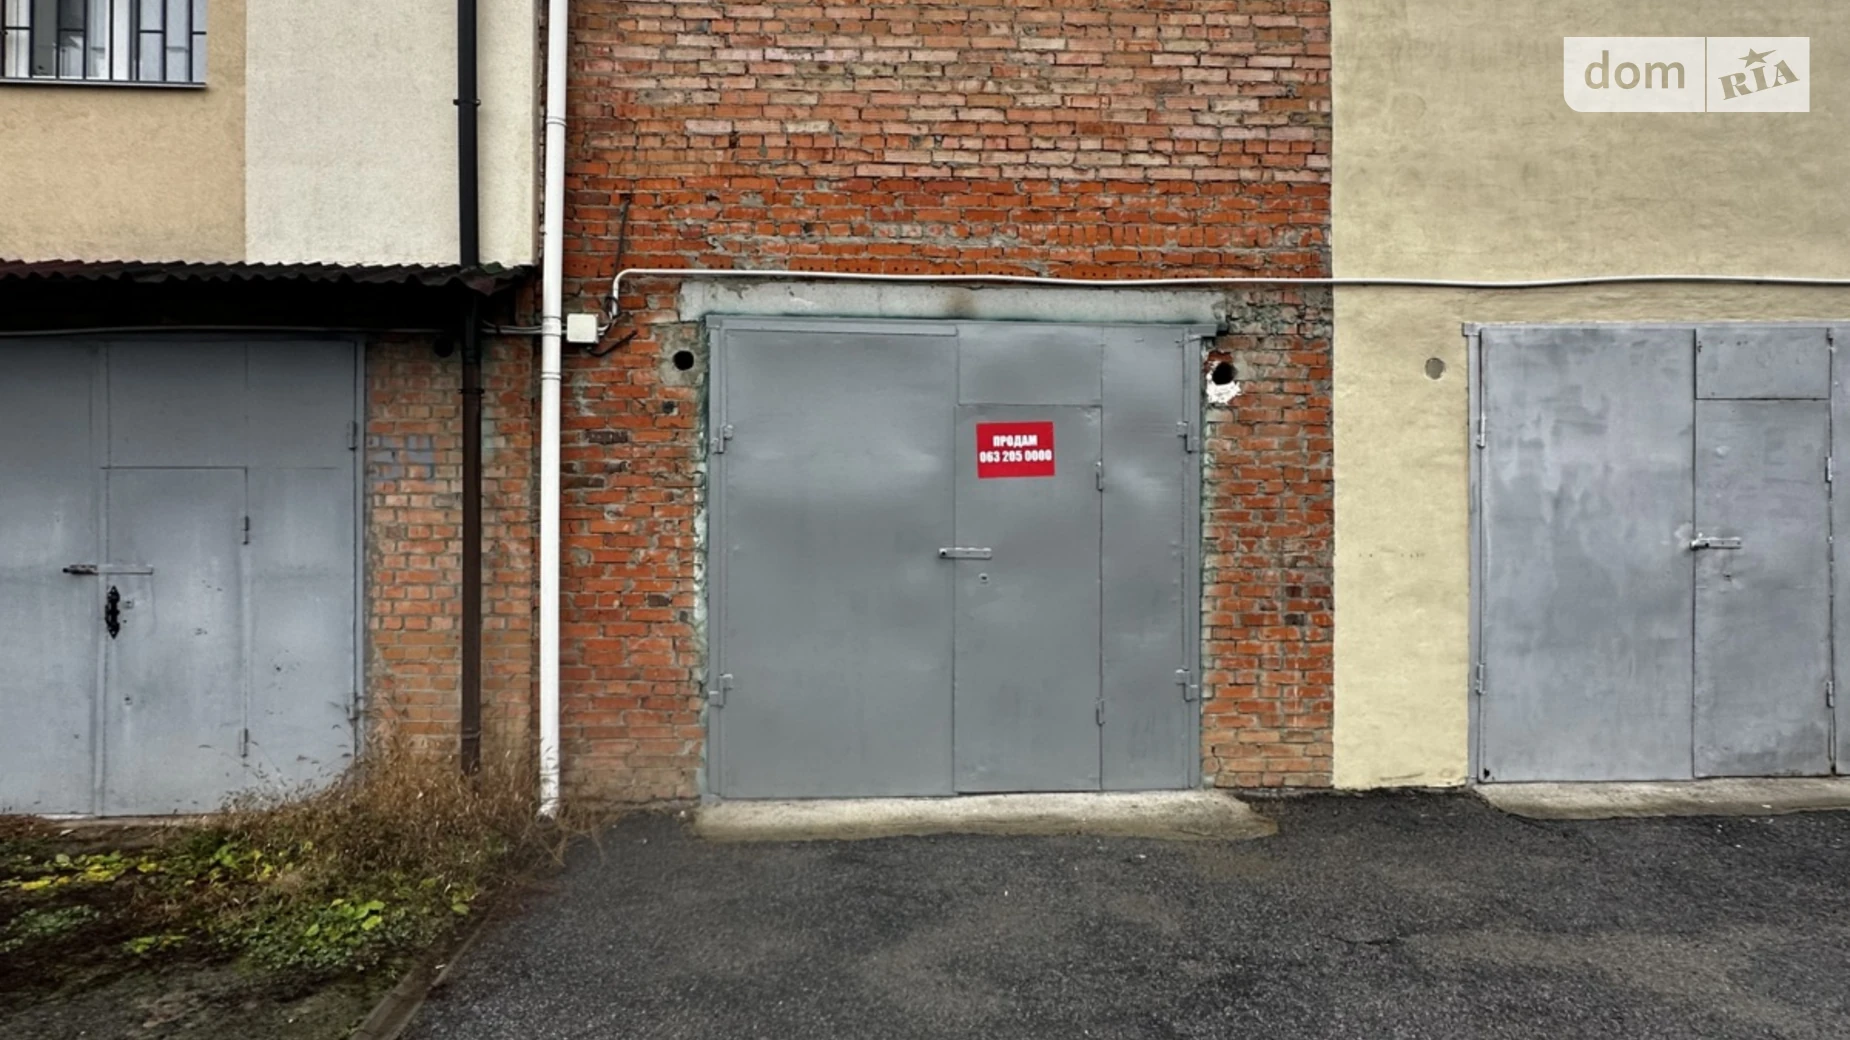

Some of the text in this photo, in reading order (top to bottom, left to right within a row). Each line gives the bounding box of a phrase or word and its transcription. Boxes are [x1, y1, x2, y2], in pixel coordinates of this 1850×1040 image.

[993, 434, 1038, 448] ПРОДАМ
[979, 449, 1052, 463] 063 205 0000
